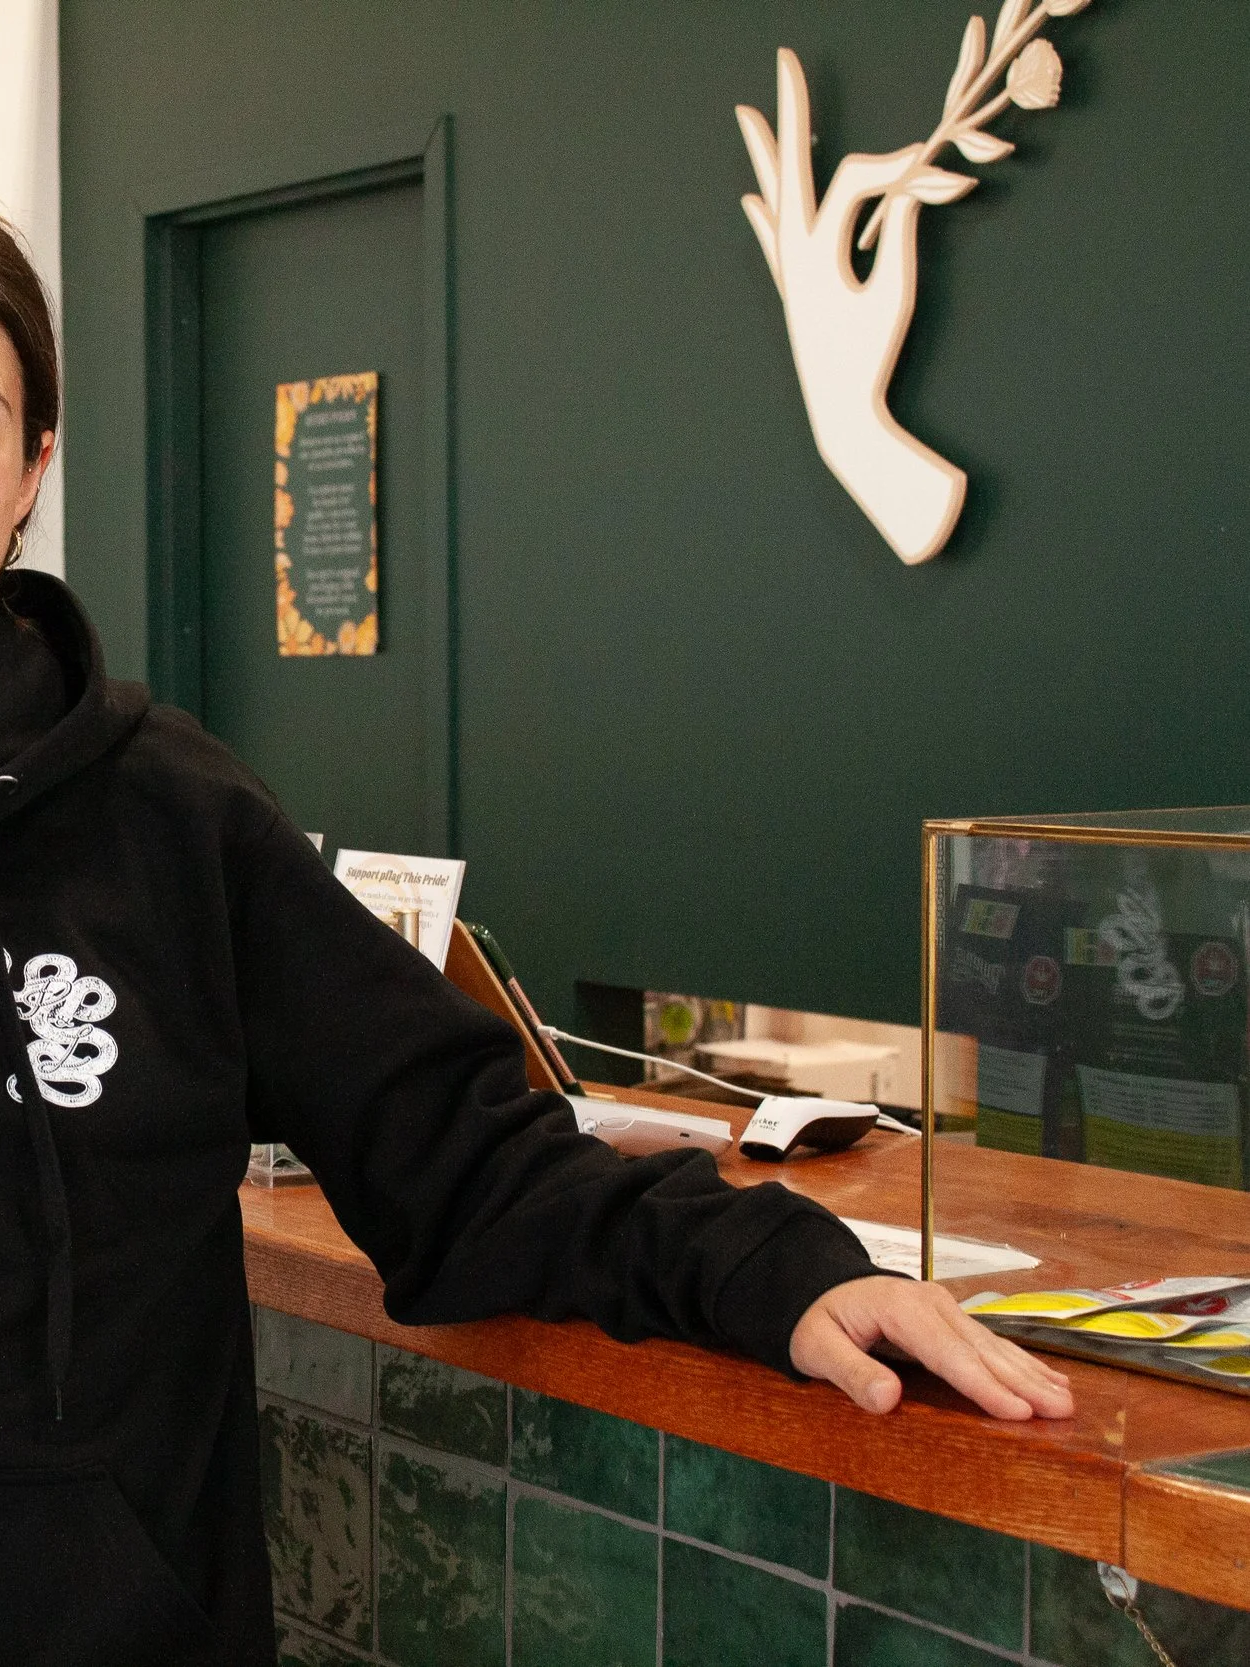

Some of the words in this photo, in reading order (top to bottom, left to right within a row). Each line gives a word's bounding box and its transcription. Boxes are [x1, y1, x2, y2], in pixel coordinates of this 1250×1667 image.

[346, 866, 380, 881] Support
[403, 871, 423, 884] This
[422, 874, 450, 887] Pride!
